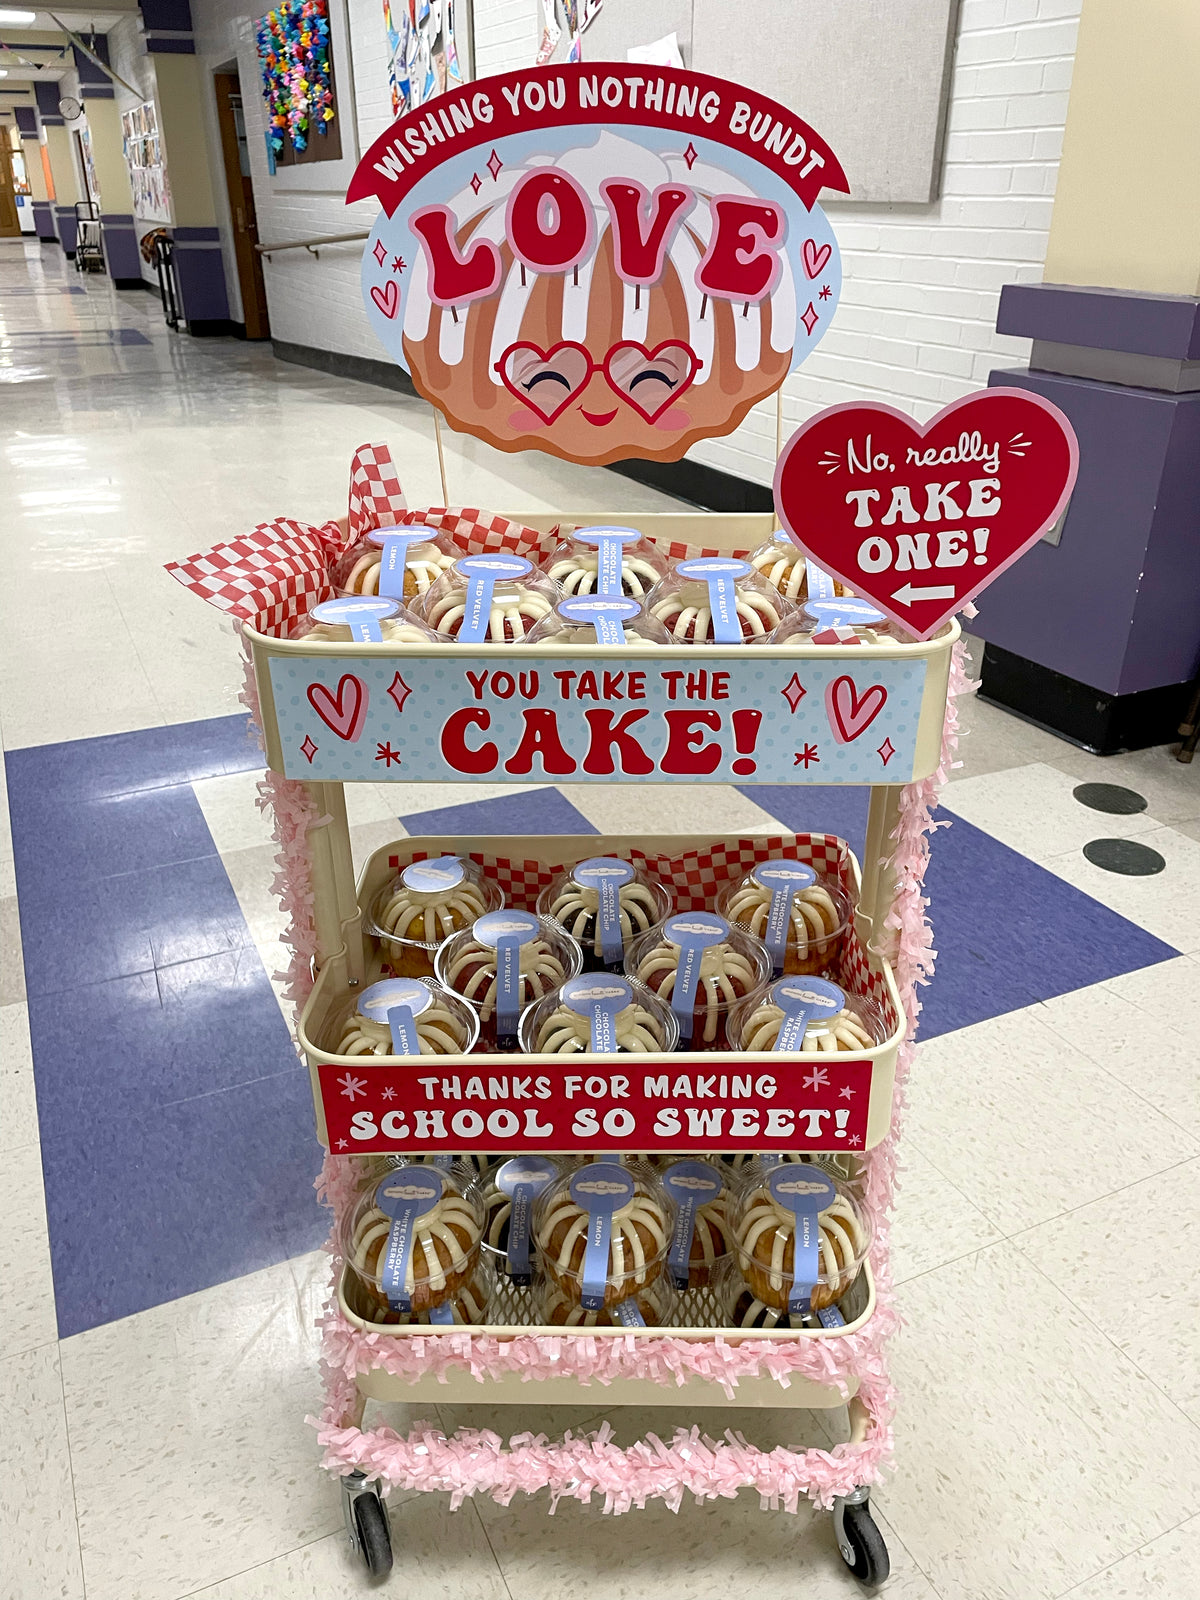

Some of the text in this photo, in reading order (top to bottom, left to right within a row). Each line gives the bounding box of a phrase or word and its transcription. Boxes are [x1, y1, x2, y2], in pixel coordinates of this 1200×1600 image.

[372, 74, 825, 182] WISHING YOU NOTHING BUNDT
[411, 170, 781, 300] LOVE
[847, 430, 1001, 474] No, really
[845, 477, 1002, 528] TAKE
[388, 545, 398, 570] LEMON
[857, 527, 990, 574] ONE!
[470, 580, 485, 630] RED VELVET
[719, 594, 729, 624] VELVET
[360, 624, 372, 642] LEM
[597, 615, 610, 644] CHOCOL
[466, 669, 731, 700] YOU TAKE THE
[440, 706, 764, 776] CAKE!
[608, 883, 616, 922] CHOCOLATE
[770, 890, 782, 931] RASPBERRY
[774, 902, 787, 945] CHOCOLATE
[681, 948, 695, 994] RED VELVET
[398, 1024, 410, 1055] LEMON
[594, 1004, 603, 1051] CHOCOLATE
[602, 1012, 610, 1053] CHOCOLA
[792, 1009, 807, 1031] WHITE
[417, 1074, 778, 1101] THANKS FOR MAKING
[349, 1107, 851, 1140] SCHOOL SO SWEET!
[400, 1208, 412, 1233] WHITE
[513, 1187, 523, 1229] CHOCOLATE
[518, 1194, 528, 1240] CHOCOLATE
[387, 1220, 400, 1271] RASPBERRY
[594, 1216, 603, 1247] LEMON
[677, 1196, 693, 1263] WHITE CHOCOLATE
[392, 1235, 406, 1287] CHOCOLATE
